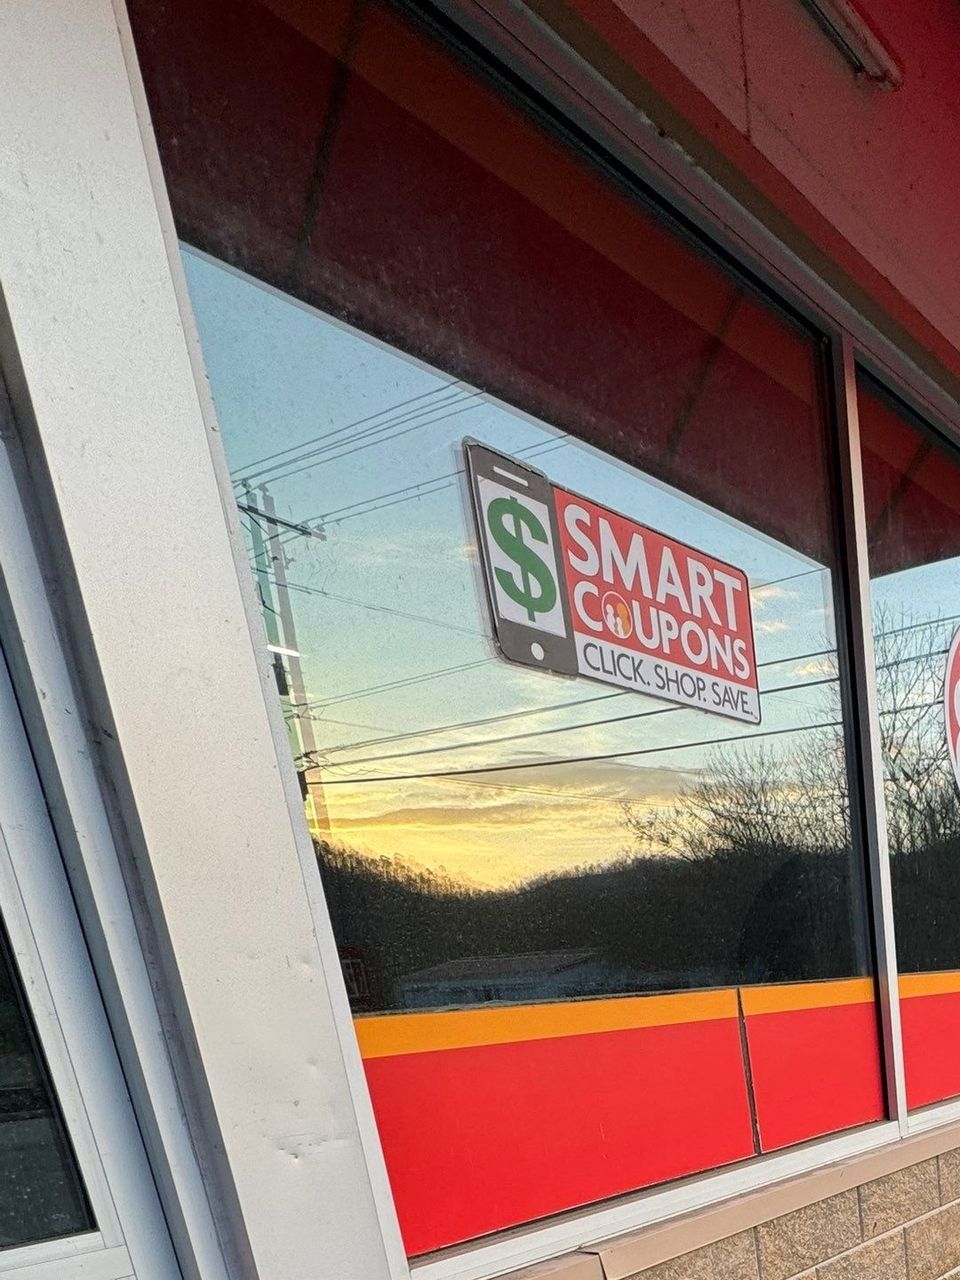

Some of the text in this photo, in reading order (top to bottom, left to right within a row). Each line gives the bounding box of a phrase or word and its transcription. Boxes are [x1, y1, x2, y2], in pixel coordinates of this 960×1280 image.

[487, 496, 557, 622] $
[564, 504, 741, 631] SMART
[573, 581, 750, 680] COUPONS
[583, 642, 753, 716] CLICK. SHOP. SAVE.
